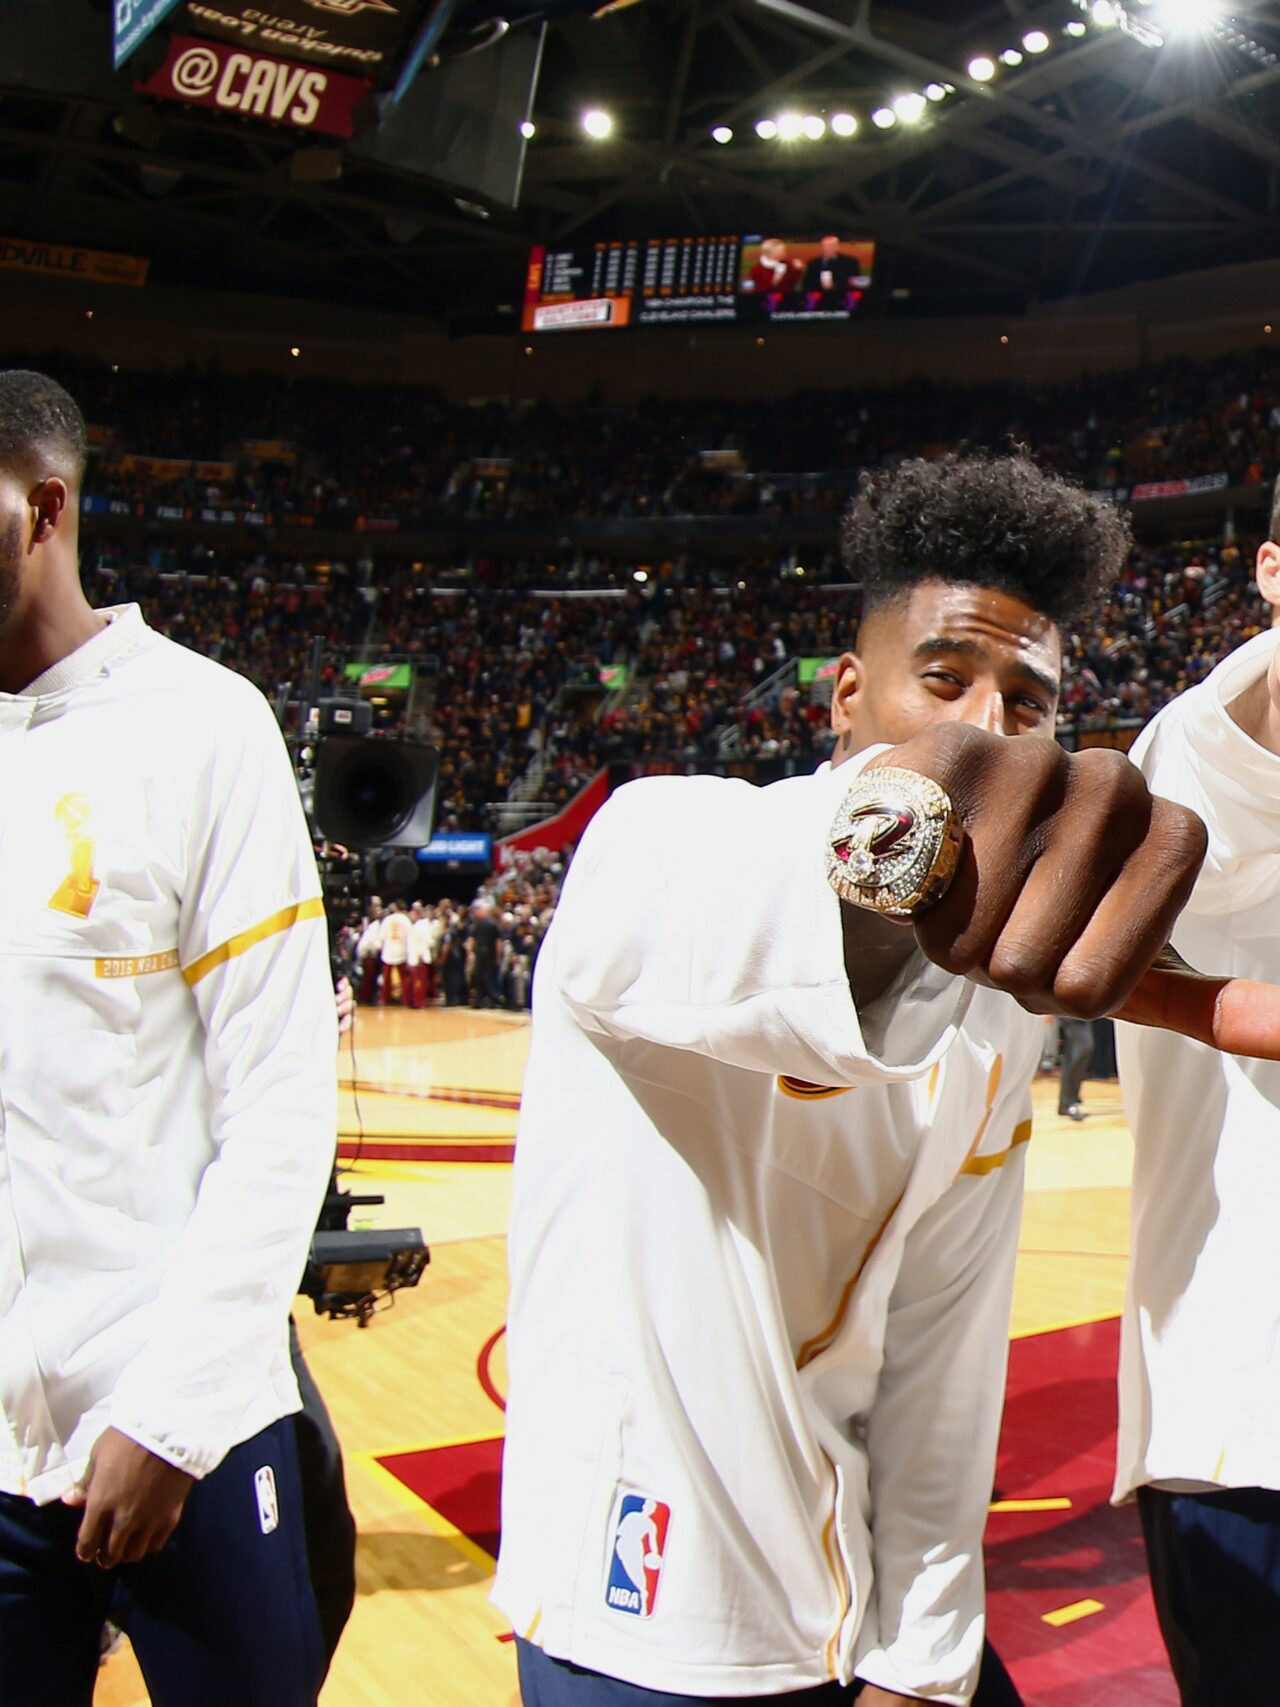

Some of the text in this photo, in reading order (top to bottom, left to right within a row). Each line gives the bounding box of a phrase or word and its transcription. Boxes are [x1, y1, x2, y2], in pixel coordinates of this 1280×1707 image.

[242, 9, 328, 38] Arena
[172, 47, 327, 124] @CAVS
[103, 959, 133, 977] 2016
[137, 956, 158, 972] NBA
[608, 1586, 639, 1609] NBA
